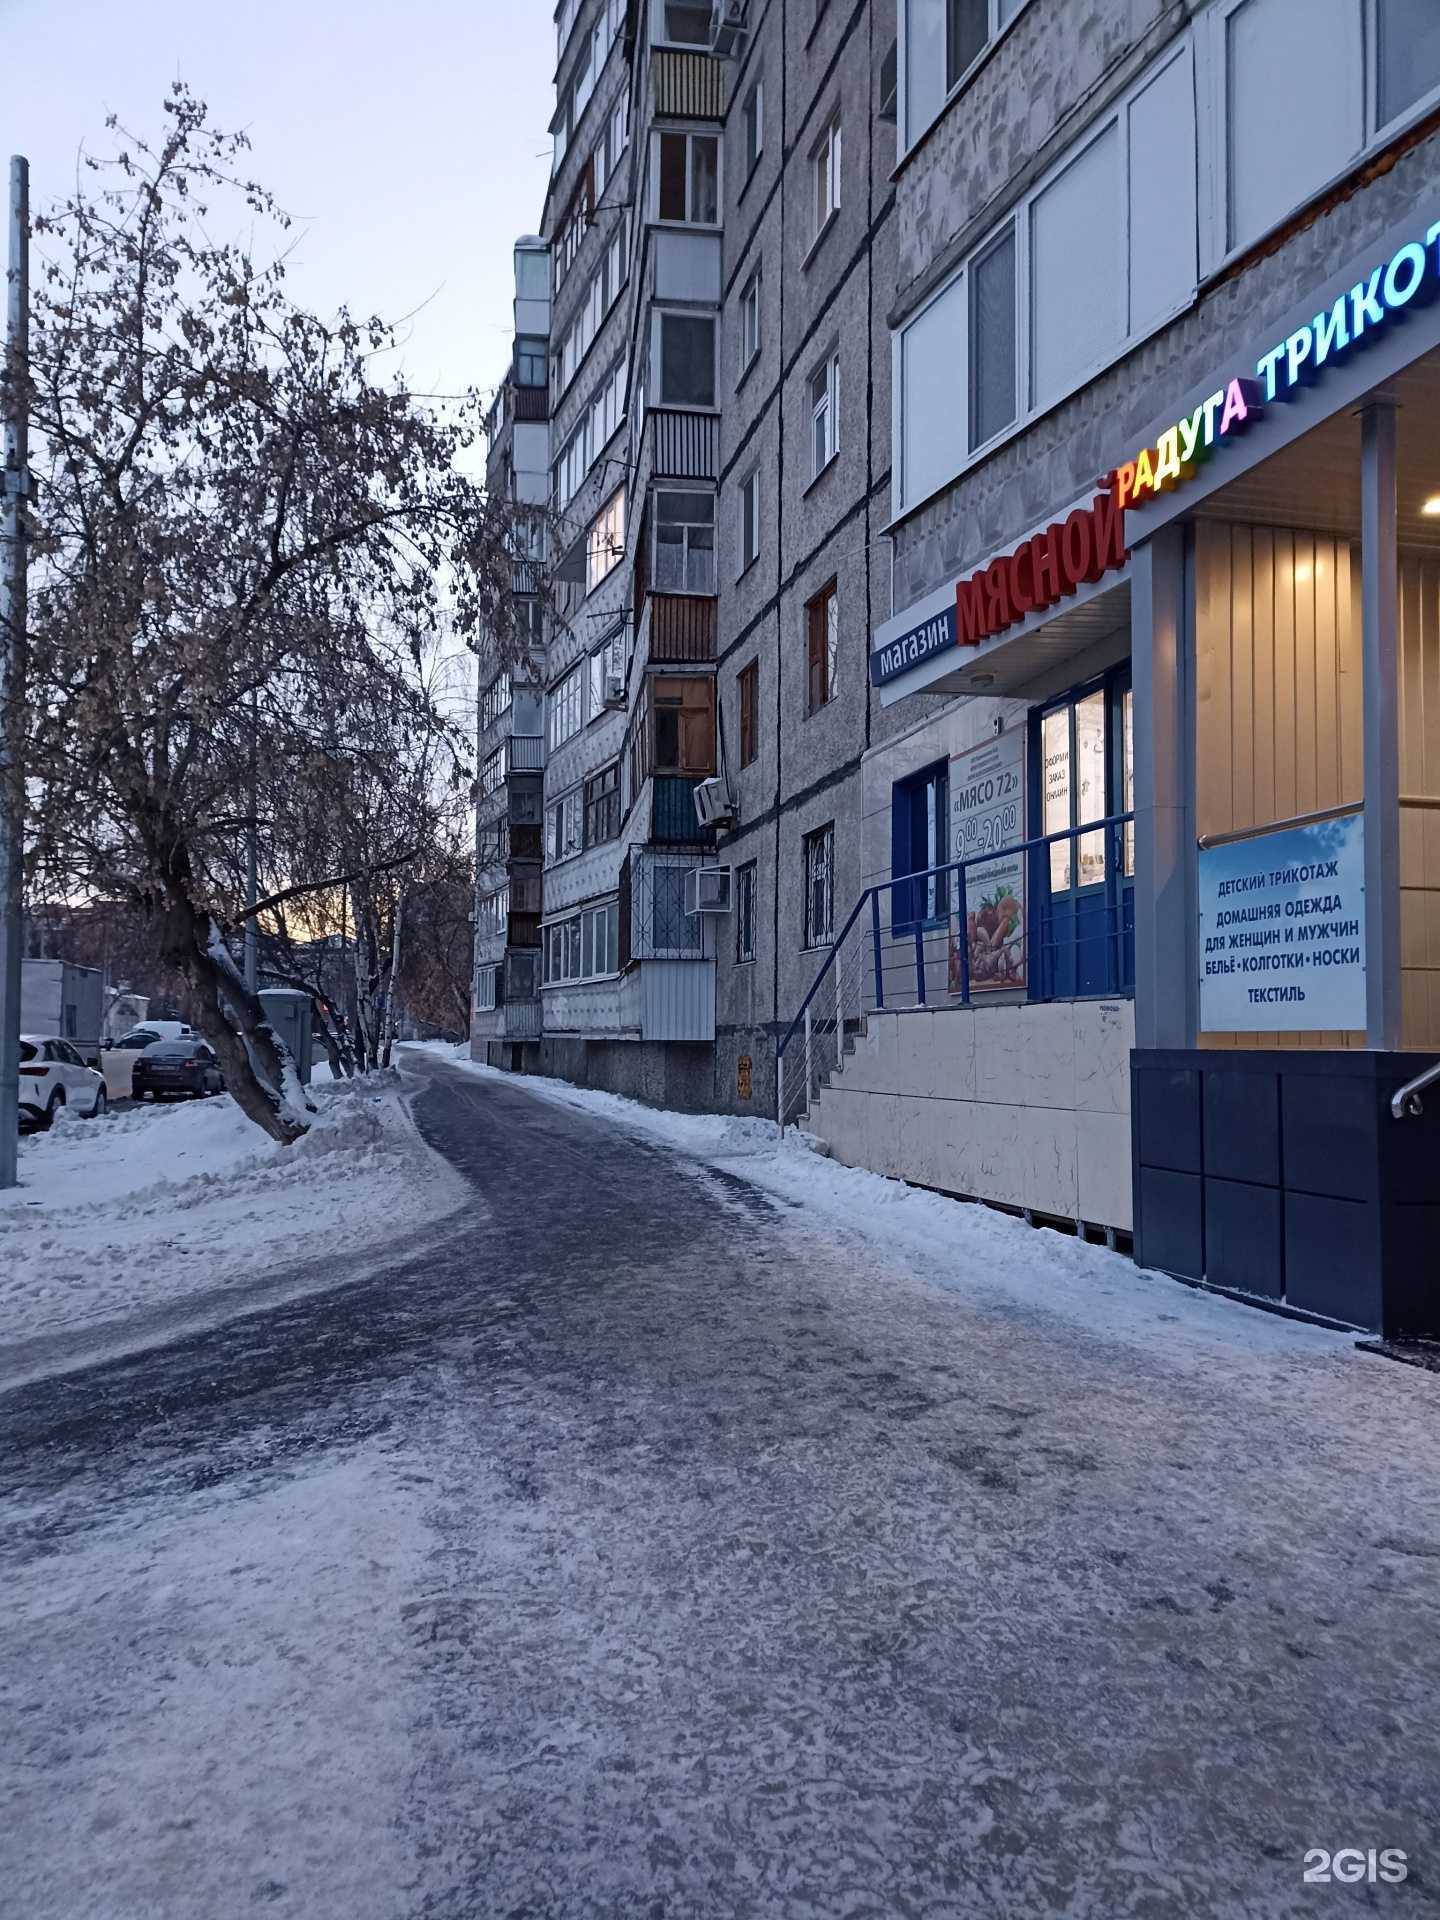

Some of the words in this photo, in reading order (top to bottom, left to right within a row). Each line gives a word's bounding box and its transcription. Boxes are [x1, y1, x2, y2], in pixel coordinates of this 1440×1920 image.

[1116, 377, 1250, 509] РАДУГА
[880, 615, 950, 676] магазин
[956, 472, 1130, 646] МЯСНОЙ
[953, 780, 994, 813] «МЯСО
[996, 772, 1018, 797] 72»
[1218, 872, 1266, 898] ДЕТСКИЙ
[1269, 860, 1339, 887] ТРИКОТАЖ
[1216, 903, 1281, 928] ДОМАШНЯЯ
[1284, 894, 1342, 918] ОДЕЖДА
[1205, 936, 1226, 954] ДЛЯ
[1228, 929, 1281, 949] ЖЕНЩИН
[1284, 927, 1294, 943] И
[1297, 920, 1359, 942] МУЖЧИН
[1247, 985, 1306, 1003] ТЕКСТИЛЬ
